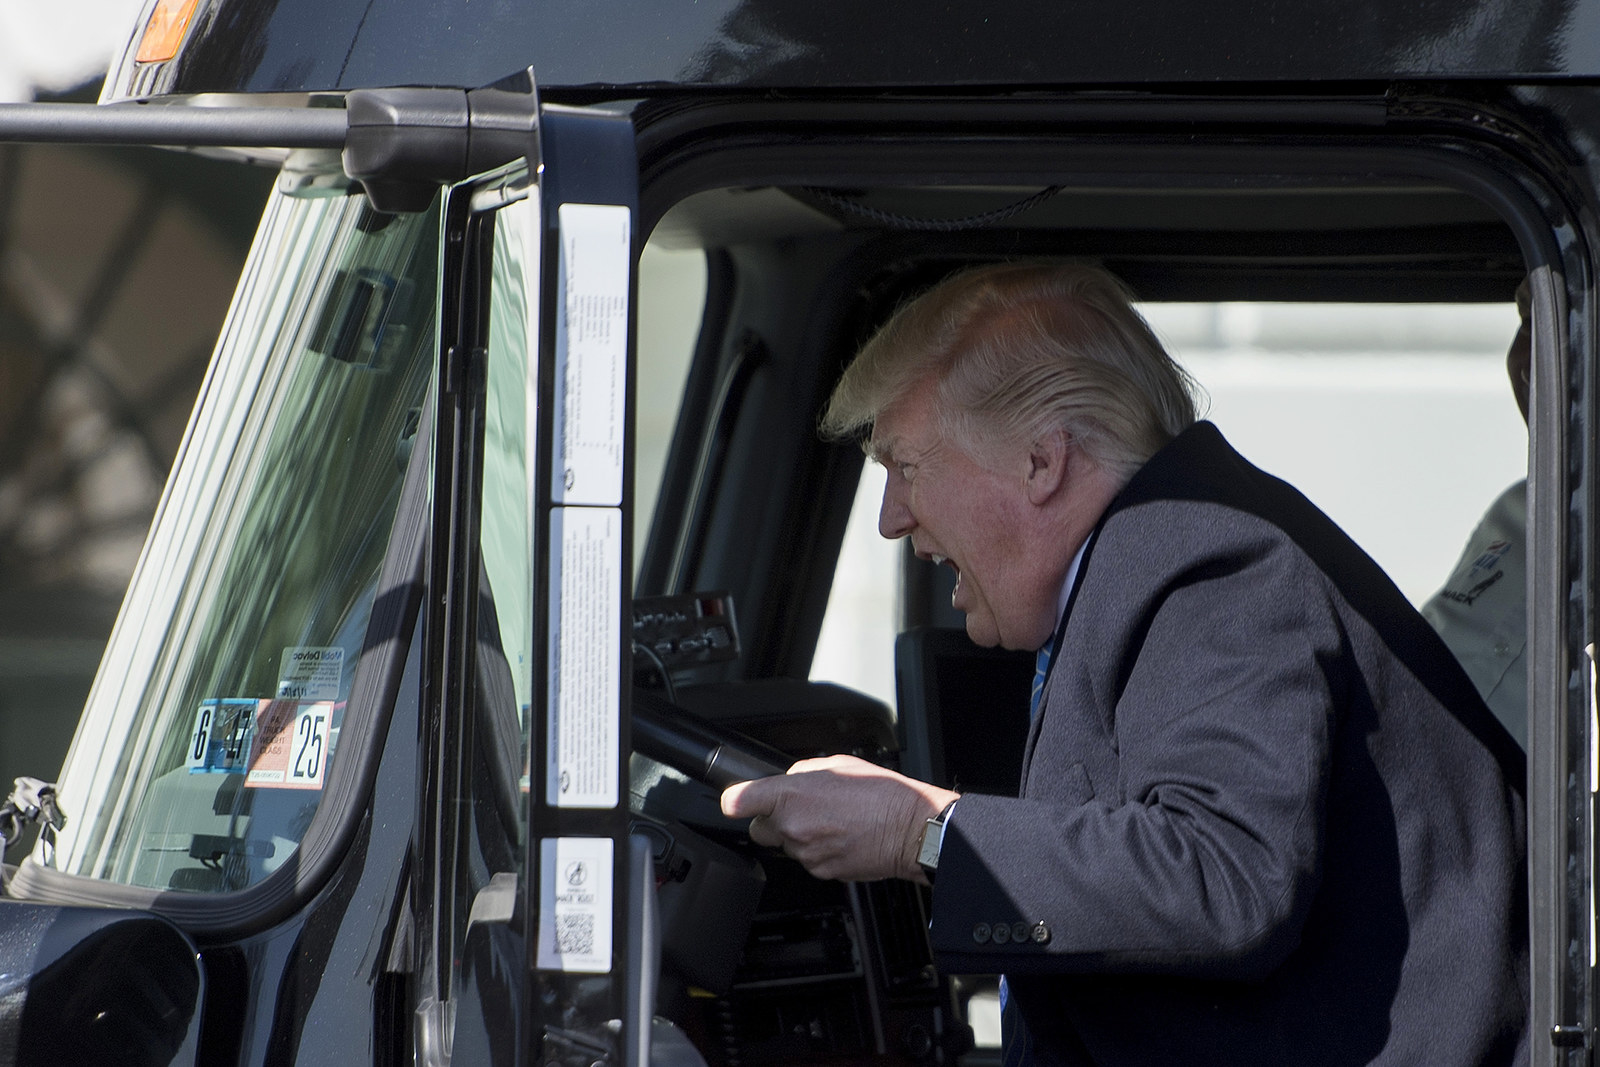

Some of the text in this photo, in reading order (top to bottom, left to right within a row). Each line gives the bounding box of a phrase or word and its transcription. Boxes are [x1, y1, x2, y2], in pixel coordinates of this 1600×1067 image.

[1440, 590, 1473, 606] MACK
[194, 709, 211, 760] 6
[259, 736, 286, 744] WEIGHT
[259, 746, 282, 755] CLASS
[294, 714, 325, 779] 25
